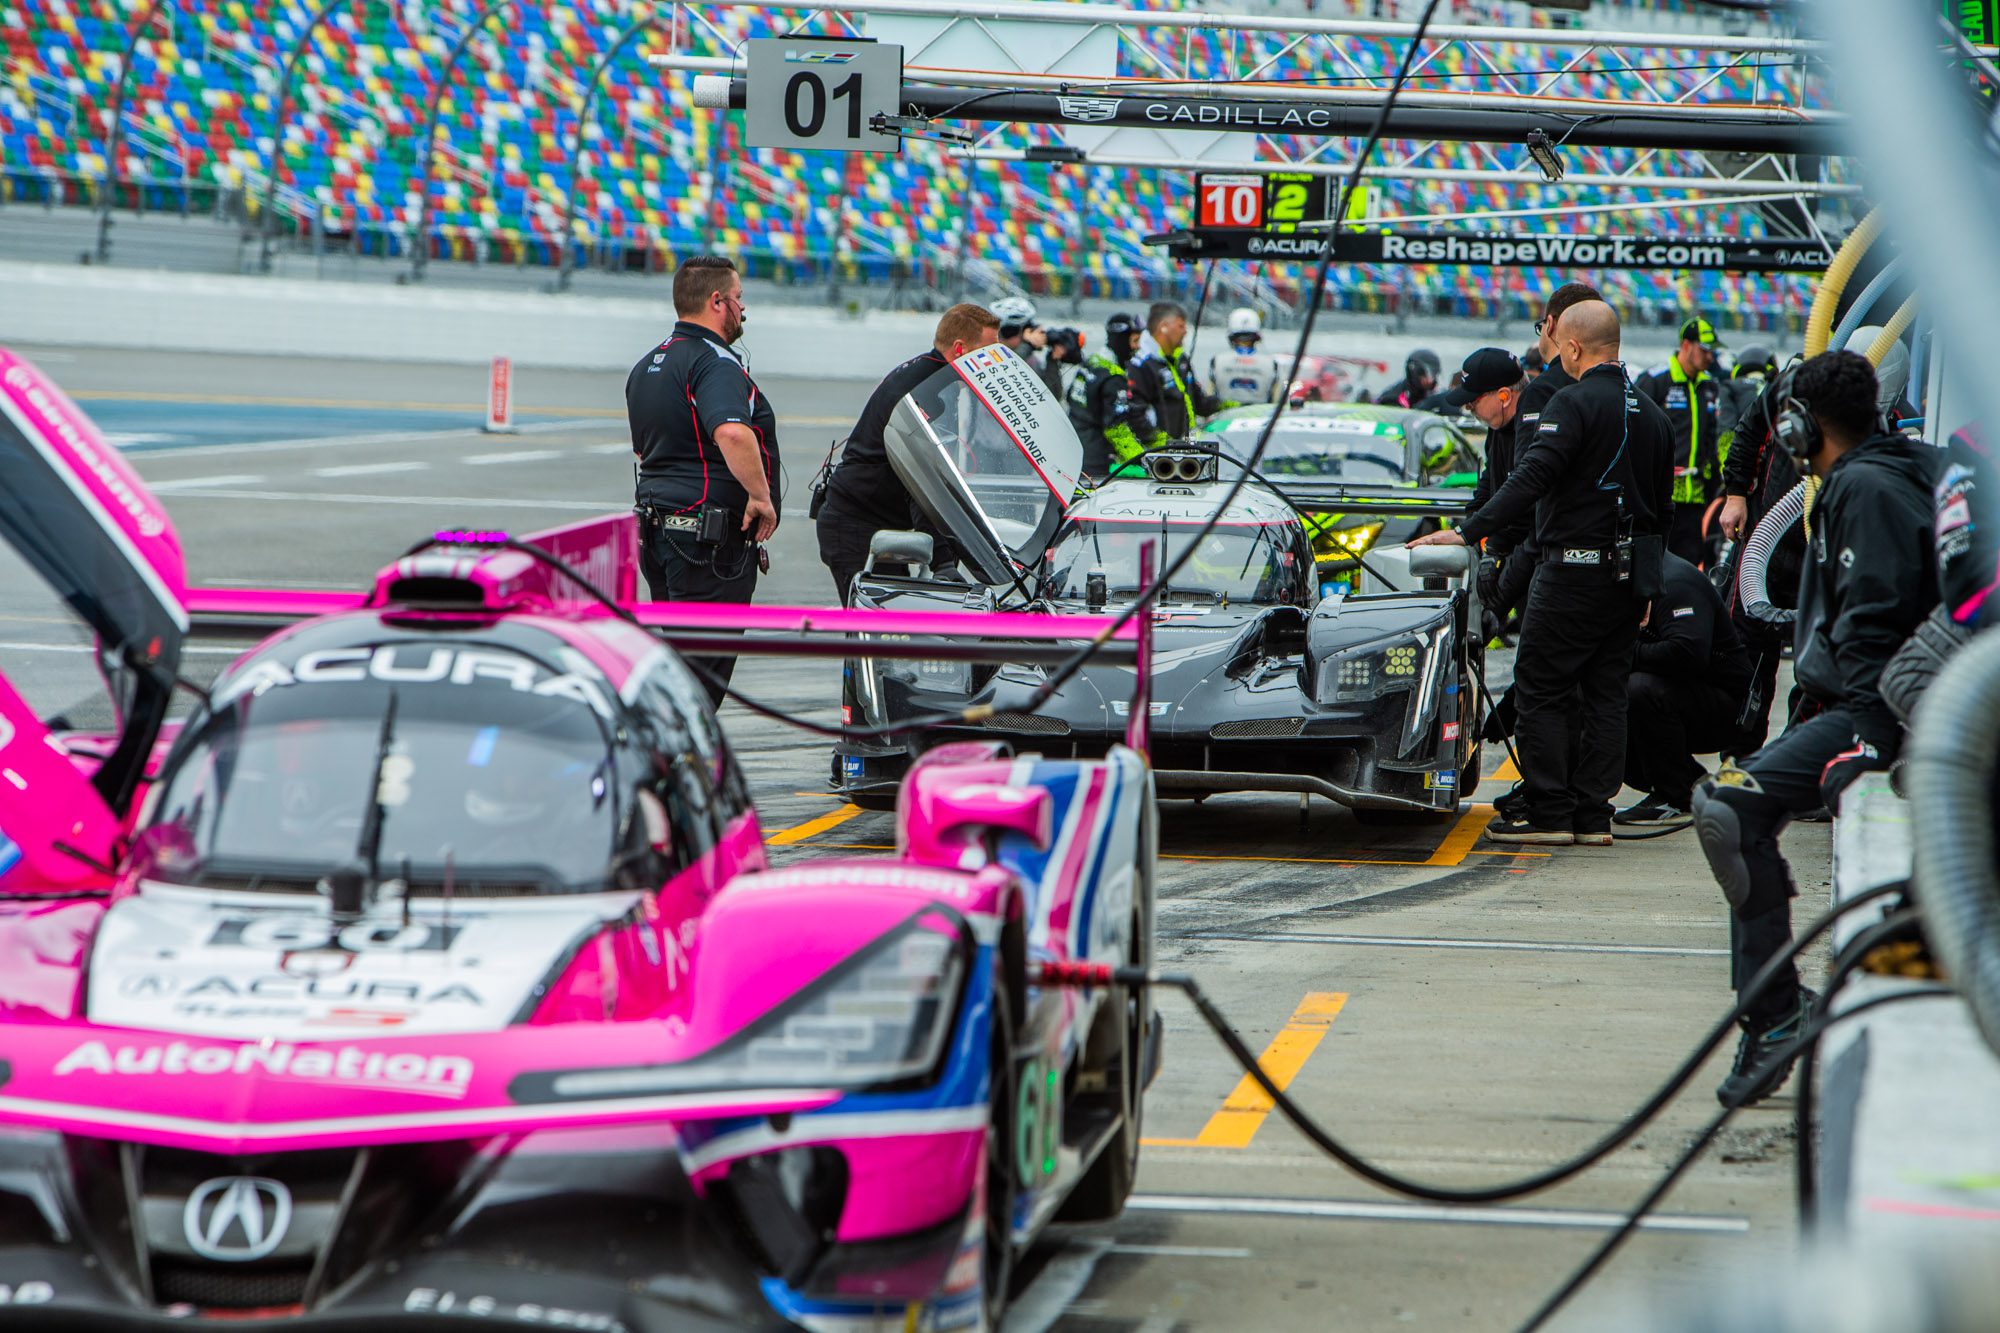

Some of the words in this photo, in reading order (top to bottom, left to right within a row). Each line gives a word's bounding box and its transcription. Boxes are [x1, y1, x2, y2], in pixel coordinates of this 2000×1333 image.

[1958, 0, 1984, 45] EAD
[785, 70, 862, 139] 01
[1145, 103, 1331, 127] CADILLAC
[1206, 186, 1256, 224] 10
[1273, 183, 1307, 220] 2
[1263, 239, 1335, 255] ACURA
[1382, 235, 1725, 265] ReshapeWork.com
[1789, 251, 1834, 266] ACU
[988, 367, 998, 377] S.
[997, 377, 1040, 430] BOURDAIS
[1009, 374, 1037, 406] PALOU
[1019, 371, 1047, 403] DIXON
[975, 371, 987, 384] R.
[984, 382, 1005, 405] VAN
[1001, 403, 1021, 428] DER
[1017, 427, 1047, 466] ZANDE
[1100, 507, 1241, 519] CADILLAC
[210, 645, 616, 721] ACURA
[184, 974, 486, 1006] ACURA
[55, 1040, 473, 1095] AutoNation
